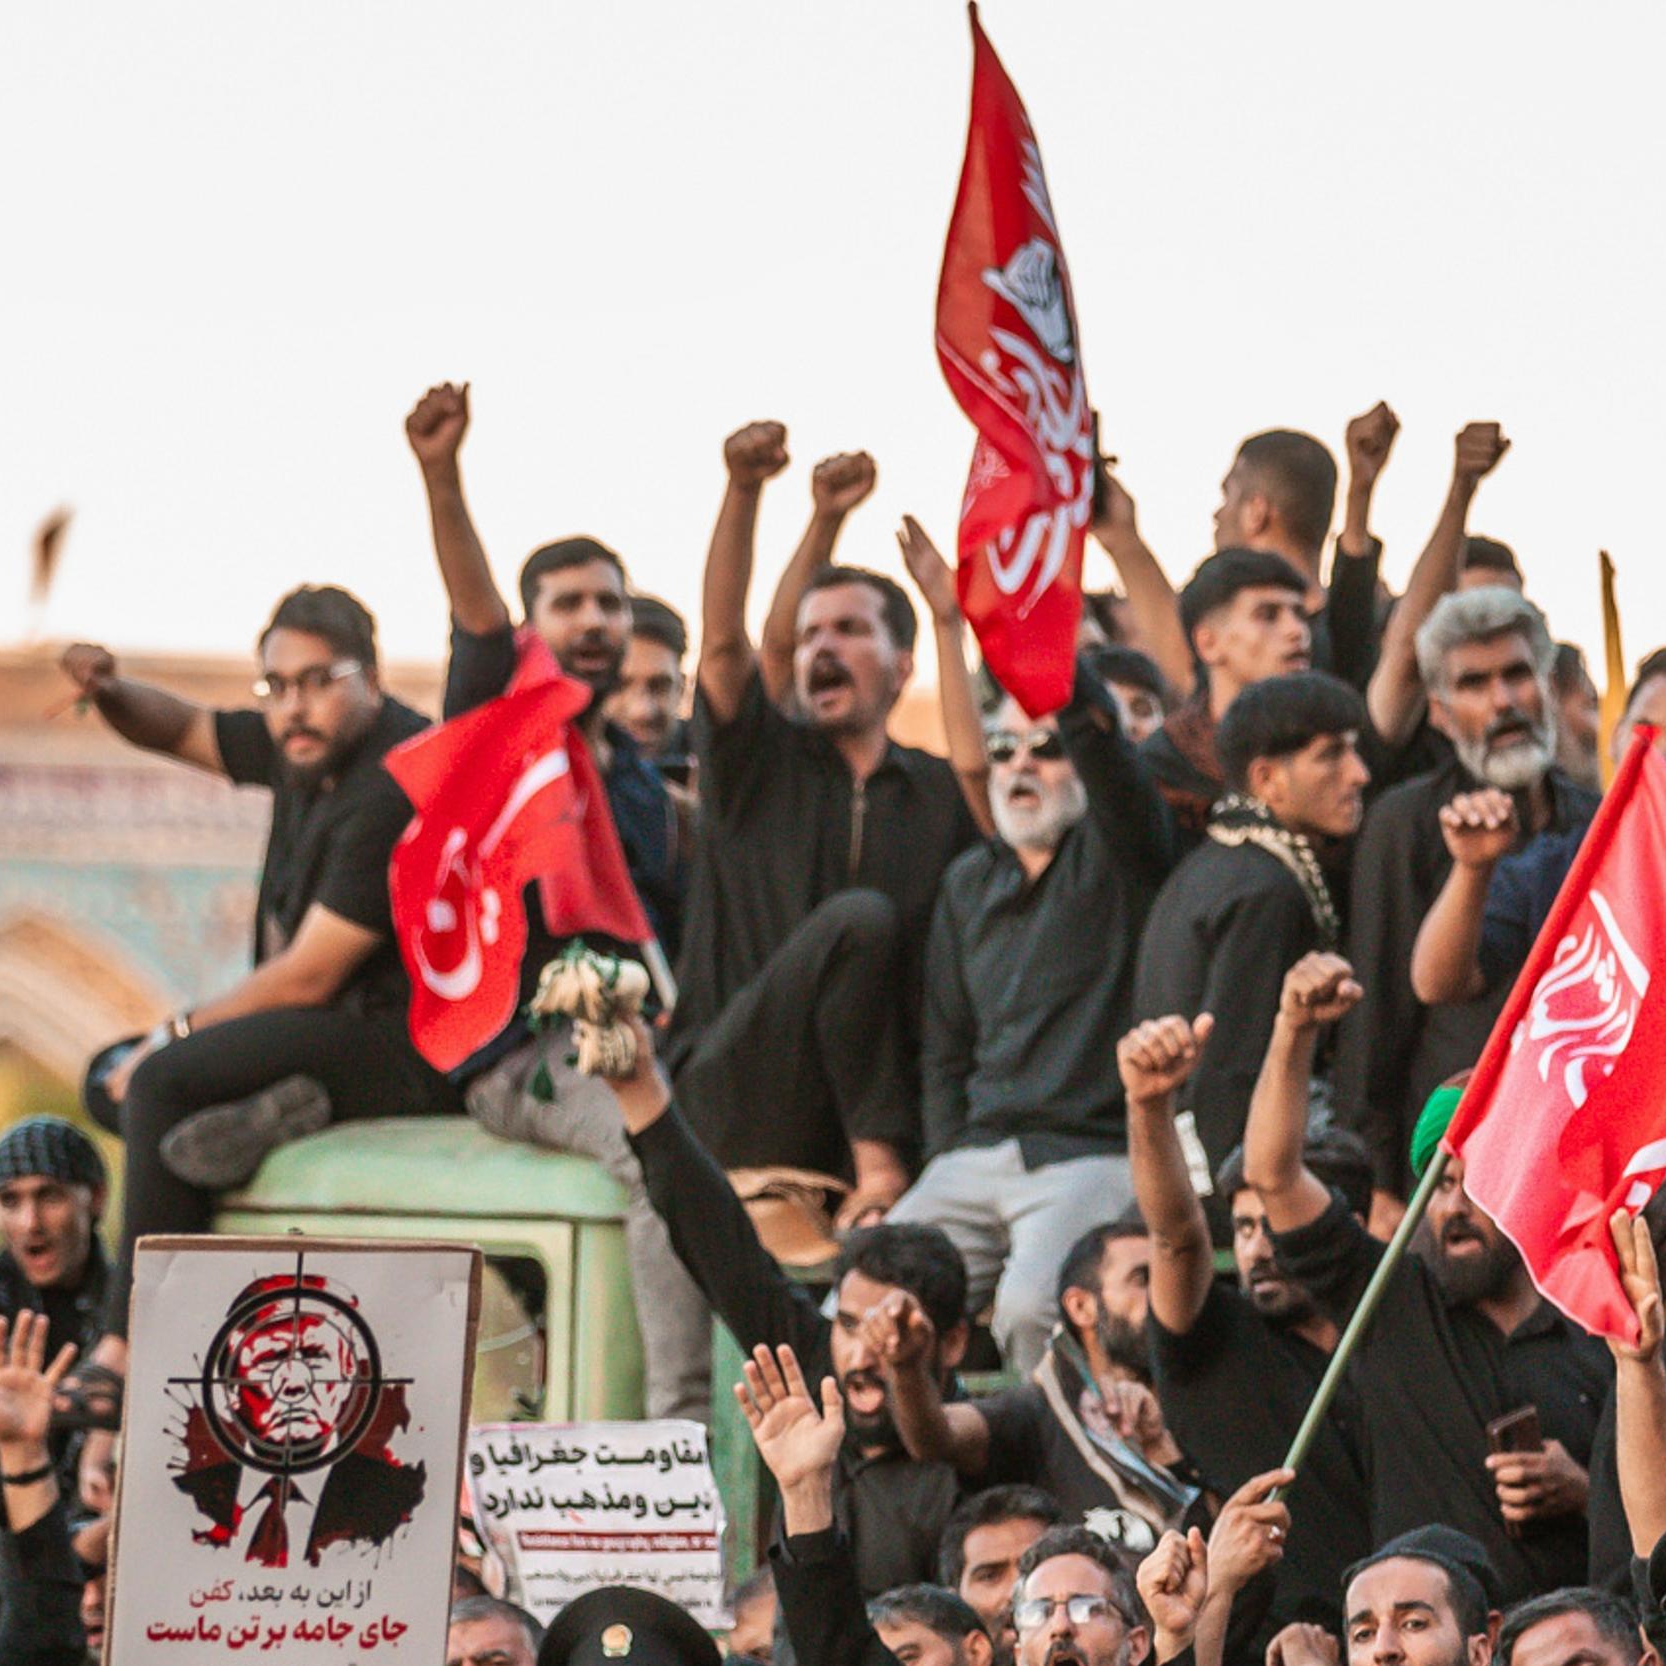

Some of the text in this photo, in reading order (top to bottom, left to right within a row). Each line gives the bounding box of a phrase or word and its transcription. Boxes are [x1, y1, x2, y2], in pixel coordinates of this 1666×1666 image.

[488, 1435, 587, 1474] جغرافیا
[484, 1486, 544, 1519] ندارد
[188, 1578, 235, 1609] کفن
[290, 1584, 311, 1607] به
[146, 1615, 222, 1642] ماست
[293, 1615, 354, 1649] جامه
[358, 1615, 408, 1649] جای
